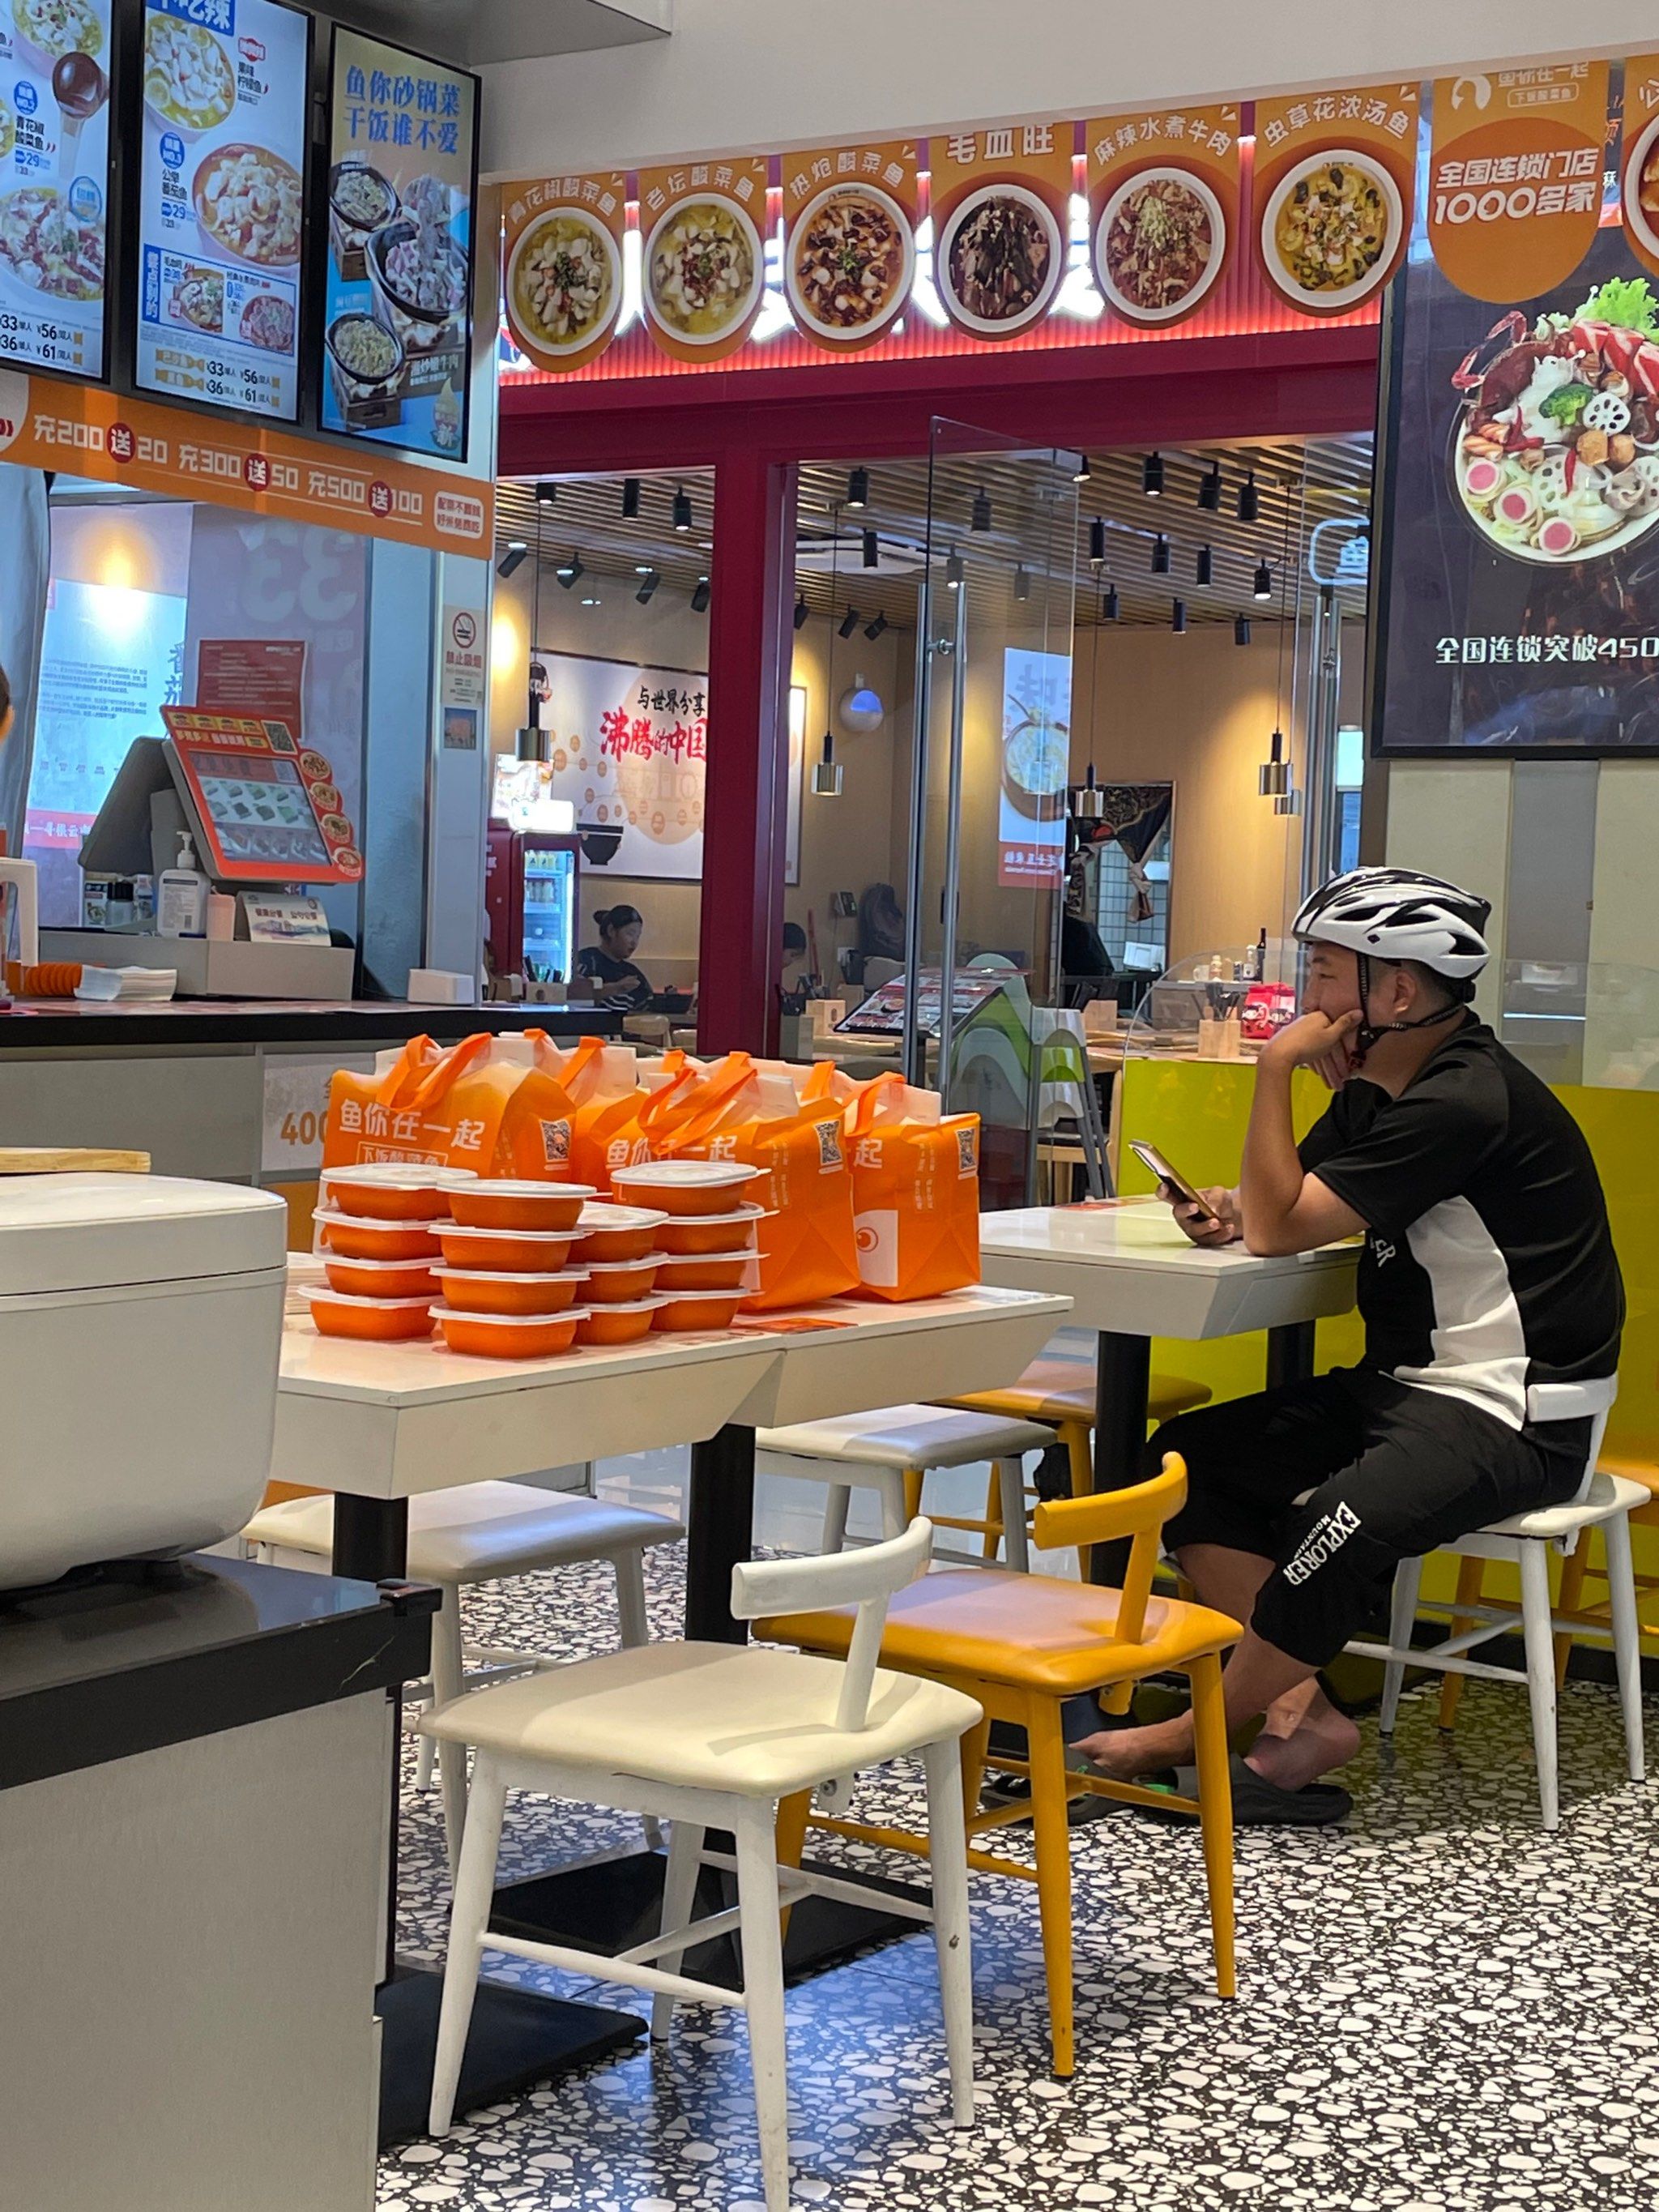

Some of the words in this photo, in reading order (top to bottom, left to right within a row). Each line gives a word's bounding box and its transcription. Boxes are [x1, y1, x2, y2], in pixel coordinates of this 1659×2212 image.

[344, 65, 460, 117] 鱼你砂锅菜
[343, 106, 458, 156] 干饭谁不爱
[946, 123, 1054, 164] 毛血旺
[1094, 115, 1231, 165] 麻辣水煮牛肉
[1264, 95, 1410, 147] 虫草花浓汤鱼
[645, 165, 755, 211] 老坛酸菜鱼
[1436, 147, 1599, 189] 全国连锁门店
[507, 177, 617, 224] 青花椒酸菜鱼
[1435, 181, 1597, 225] 1000多家
[446, 651, 482, 669] 禁止吸烟
[1435, 634, 1659, 664] 全国连锁突破450
[638, 685, 706, 717] 与世界分享
[599, 707, 709, 765] 沸腾的中国
[339, 1099, 485, 1151] 鱼你在一起
[1283, 1501, 1362, 1585] EXPLORER
